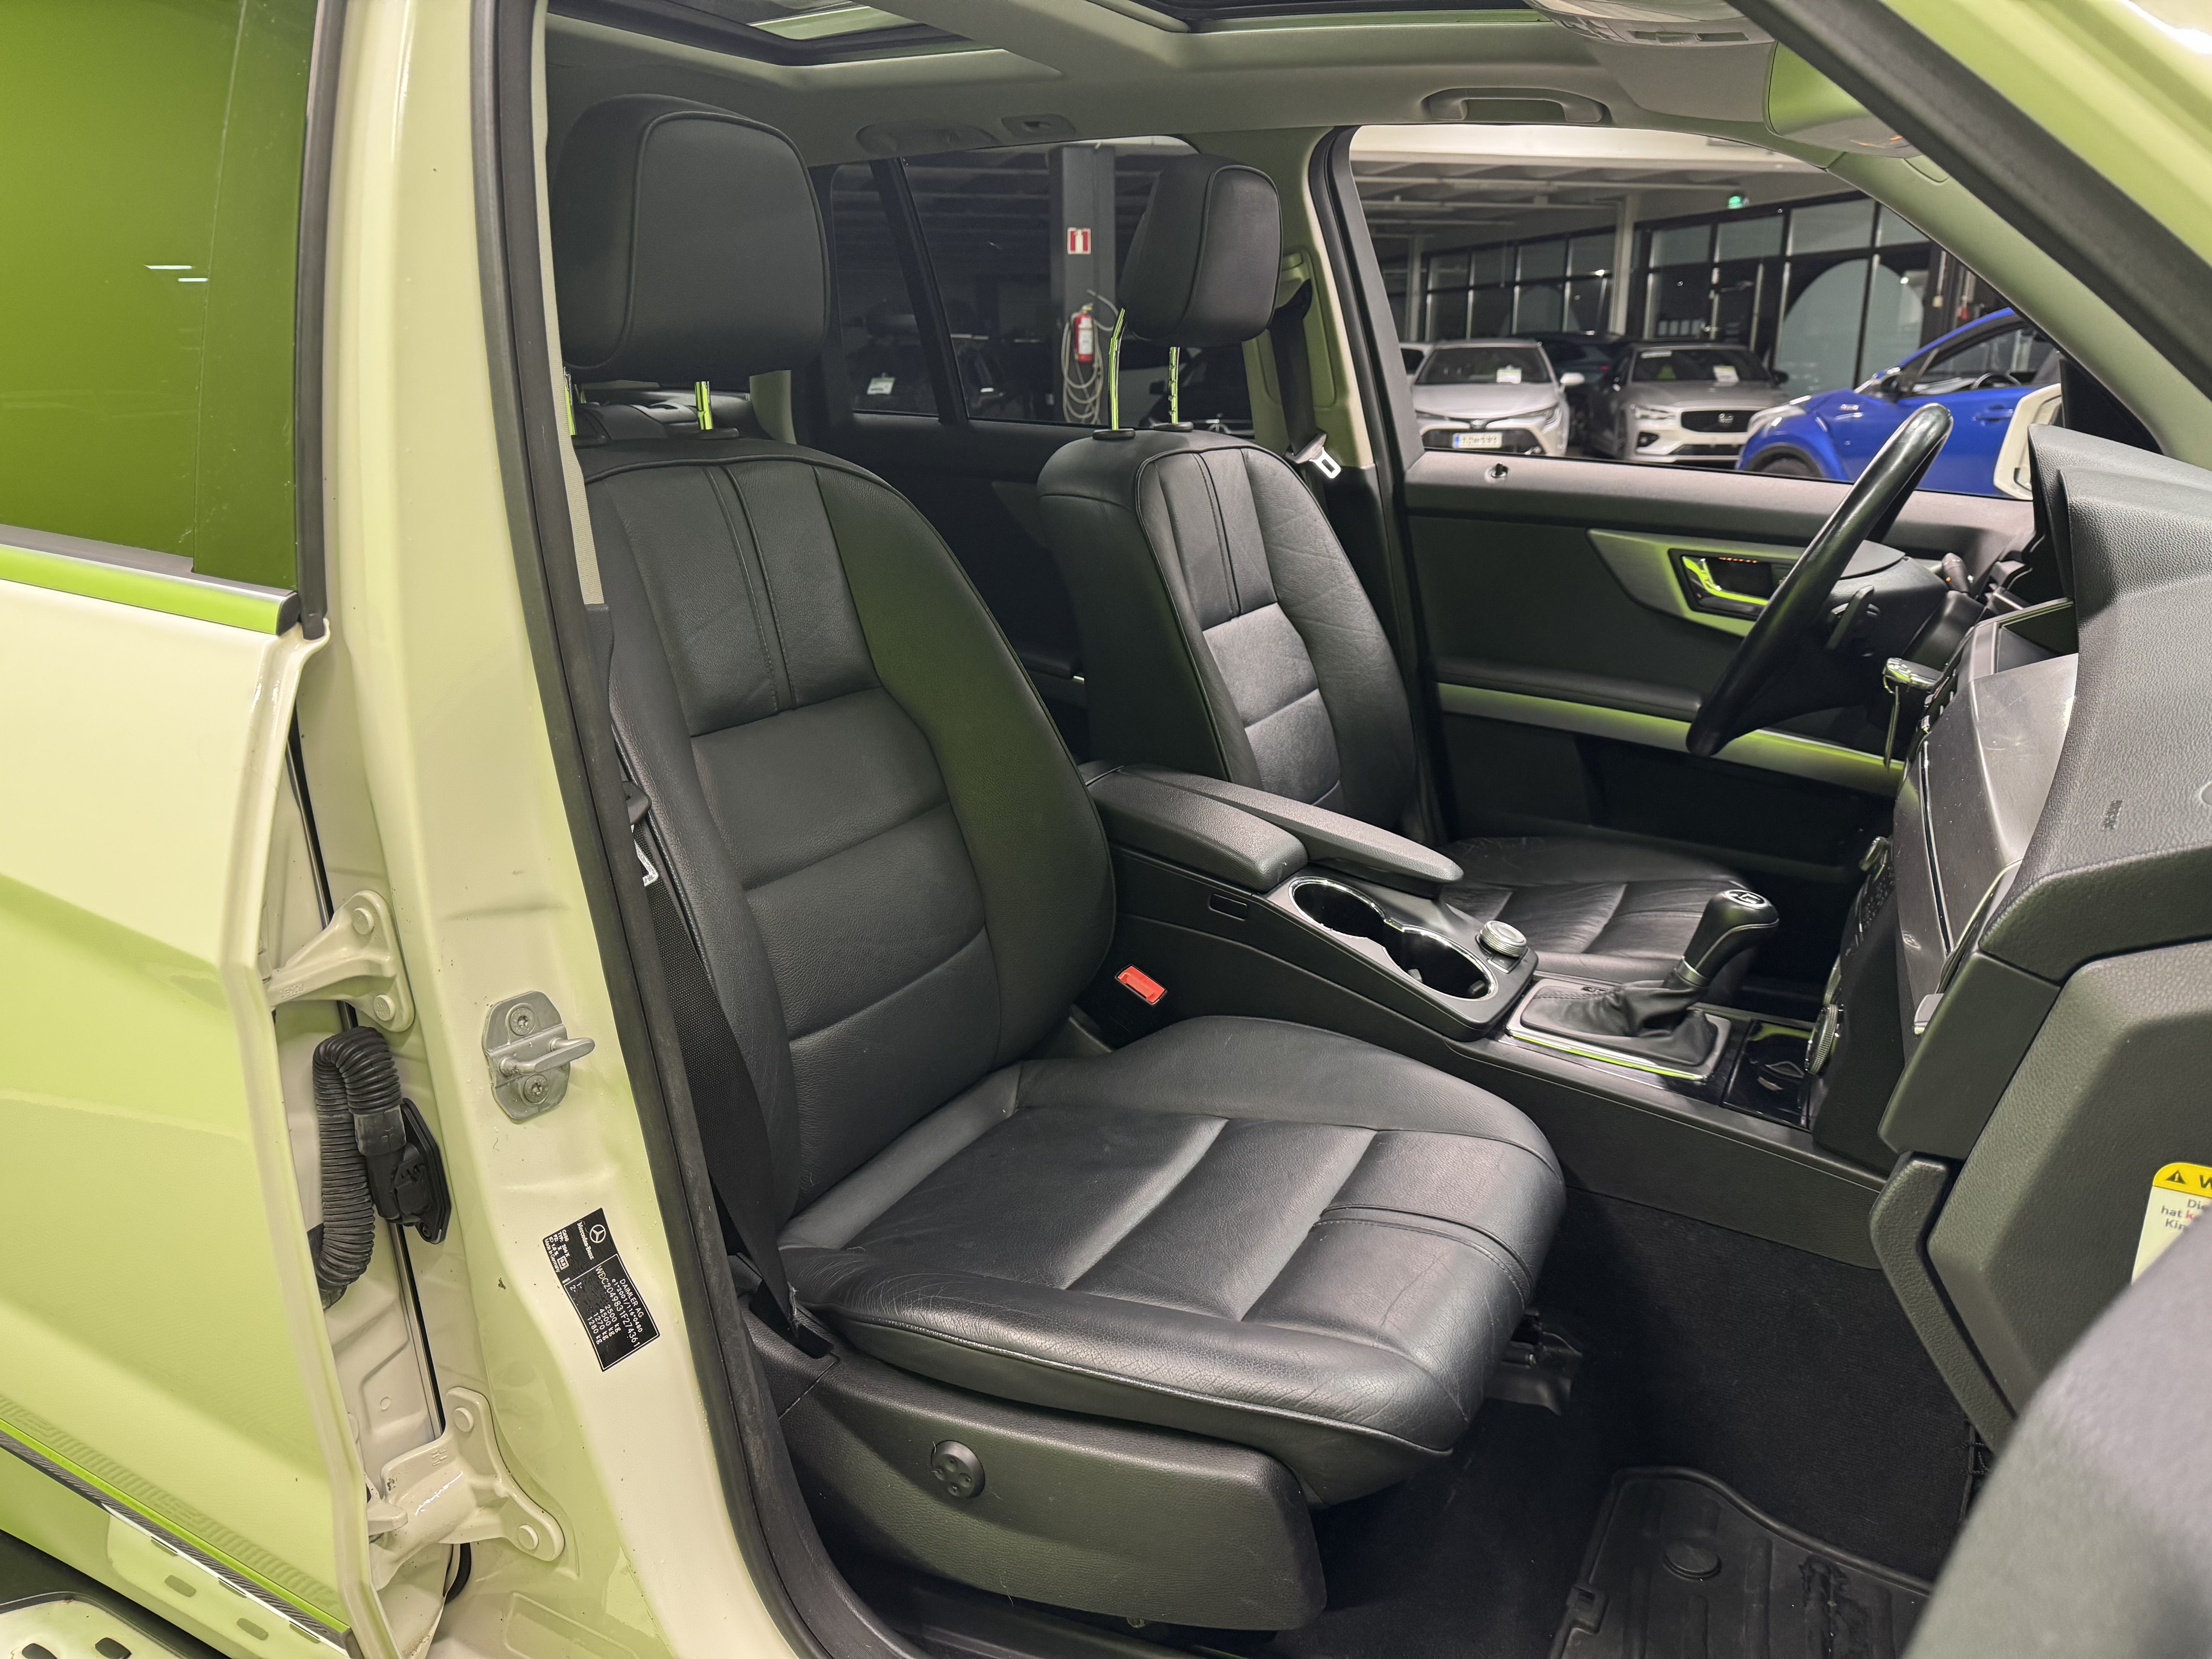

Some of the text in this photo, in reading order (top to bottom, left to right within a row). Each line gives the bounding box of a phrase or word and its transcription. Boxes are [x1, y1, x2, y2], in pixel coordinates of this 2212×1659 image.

[2161, 1205, 2182, 1218] hat
[577, 1221, 594, 1260] Mercedes-Benz
[550, 1254, 560, 1272] Germany
[595, 1265, 641, 1347] WDC2049831F274361
[620, 1279, 644, 1318] DAIMLER AG
[587, 1316, 599, 1334] 1280
[596, 1334, 603, 1345] kg
[593, 1312, 605, 1330] 1270
[602, 1330, 609, 1341] kg
[600, 1309, 615, 1337] 4500 kg
[605, 1304, 621, 1333] 2500 kg
